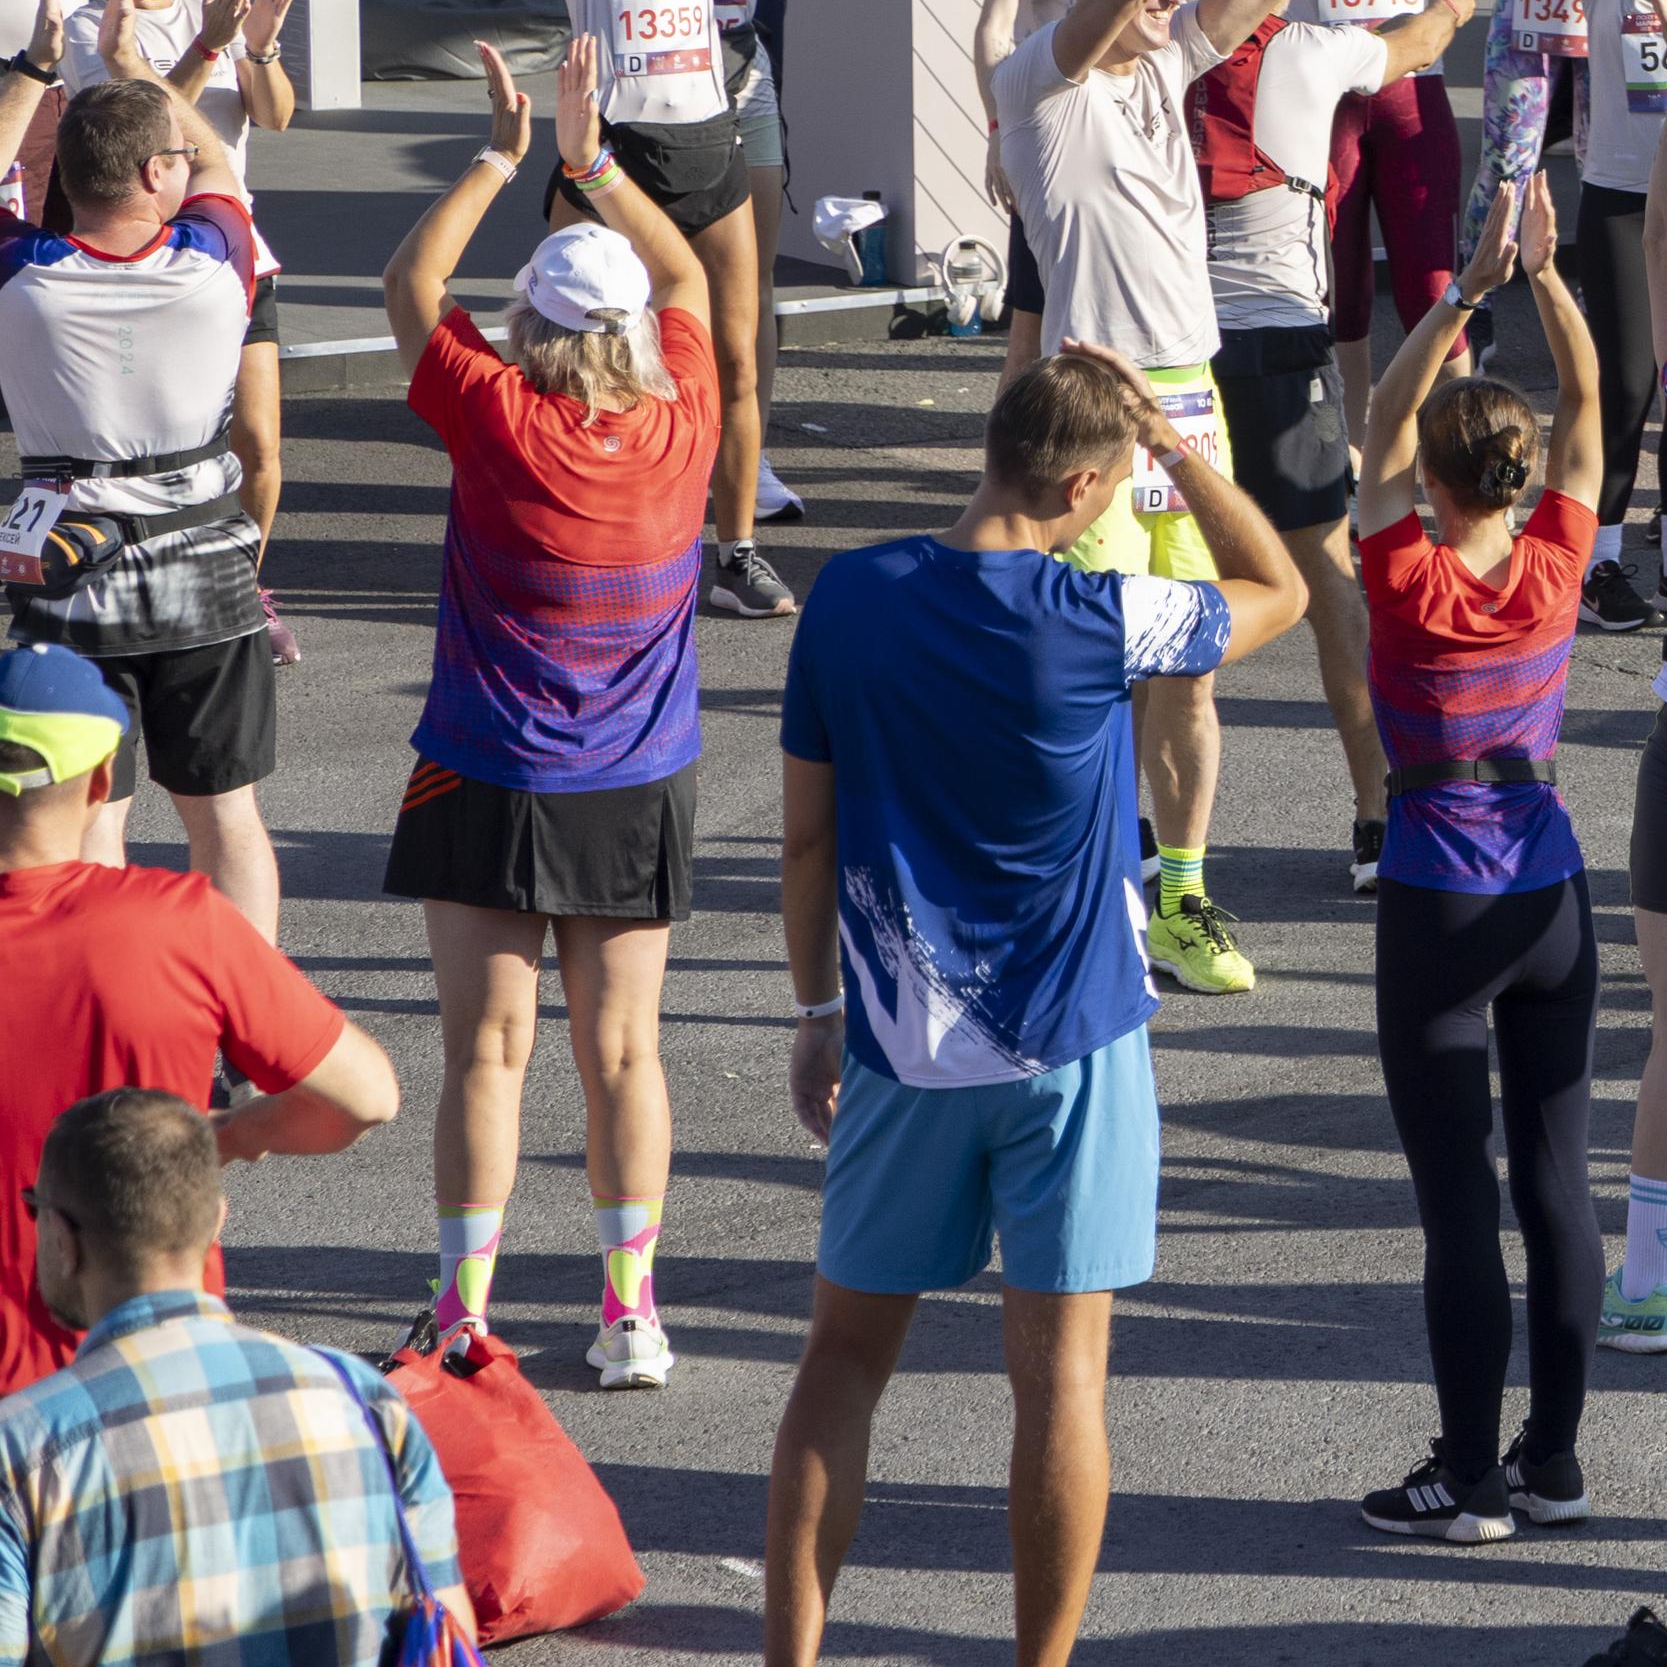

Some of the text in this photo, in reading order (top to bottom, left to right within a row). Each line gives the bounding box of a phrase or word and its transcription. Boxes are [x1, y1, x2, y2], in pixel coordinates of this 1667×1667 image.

[618, 6, 703, 41] 13359
[1523, 33, 1534, 48] D
[629, 55, 641, 73] D
[117, 325, 135, 376] 2024
[1149, 489, 1162, 508] D
